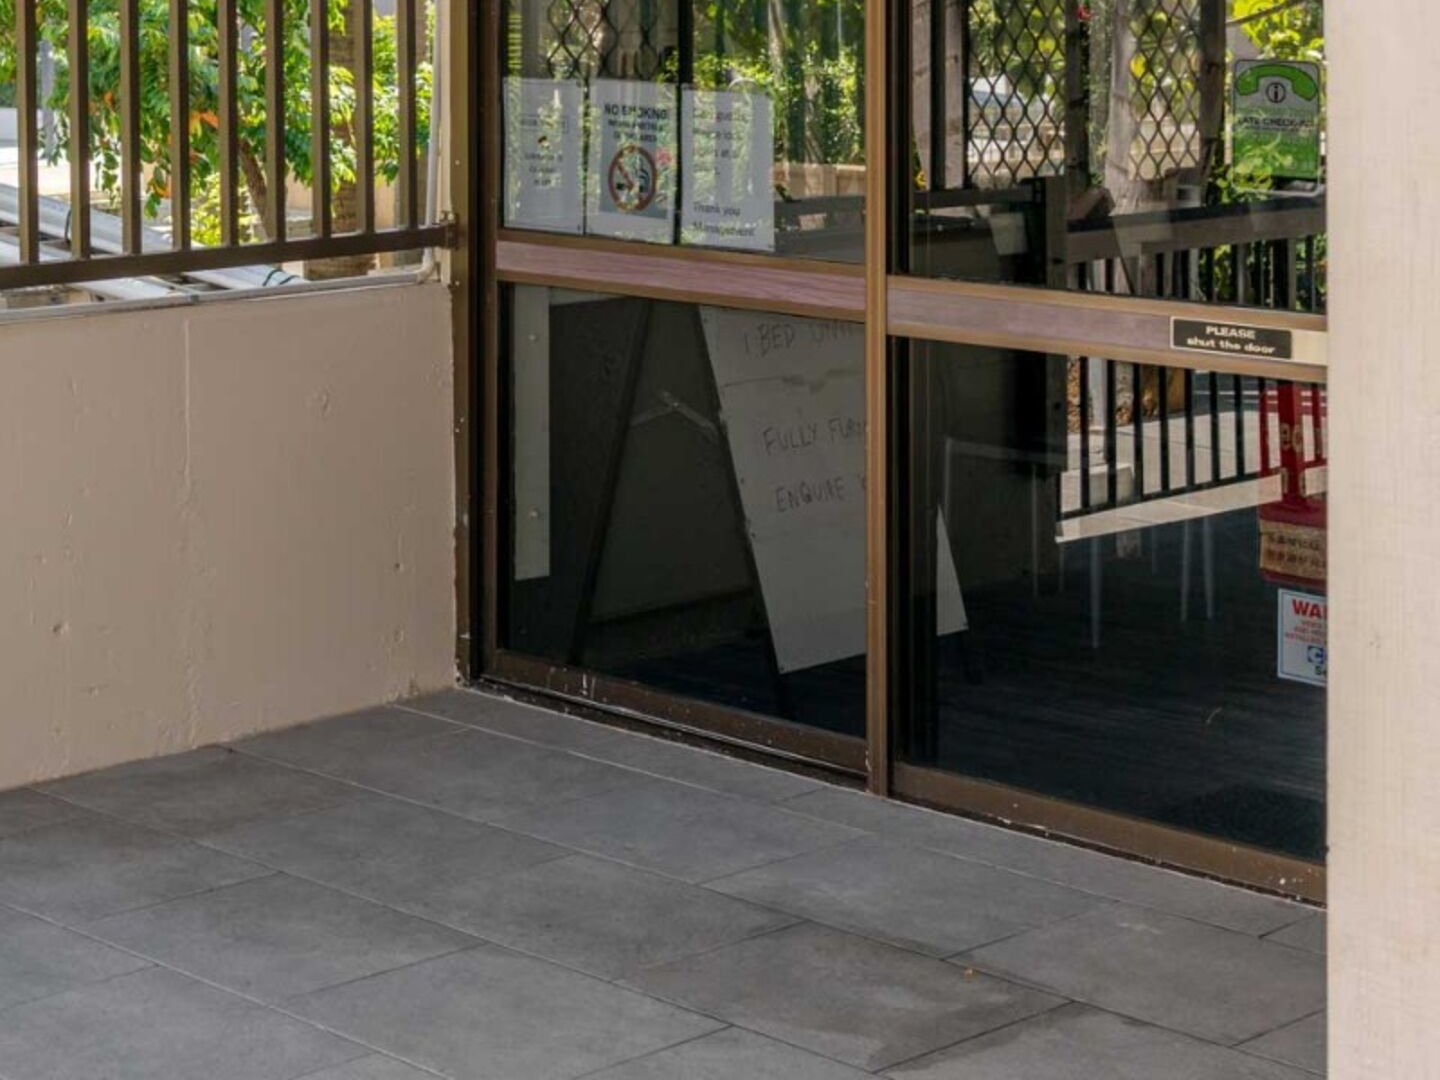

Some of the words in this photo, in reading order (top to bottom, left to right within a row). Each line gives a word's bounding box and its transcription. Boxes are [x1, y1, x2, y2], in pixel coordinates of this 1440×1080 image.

[694, 202, 720, 214] Thank
[723, 205, 741, 217] you
[757, 323, 796, 357] BED
[1186, 336, 1216, 349] shut
[1219, 339, 1242, 351] the
[1244, 342, 1276, 354] door
[1205, 325, 1257, 340] PLEASE
[763, 422, 818, 457] FULLY
[774, 475, 846, 513] ENQUIRE
